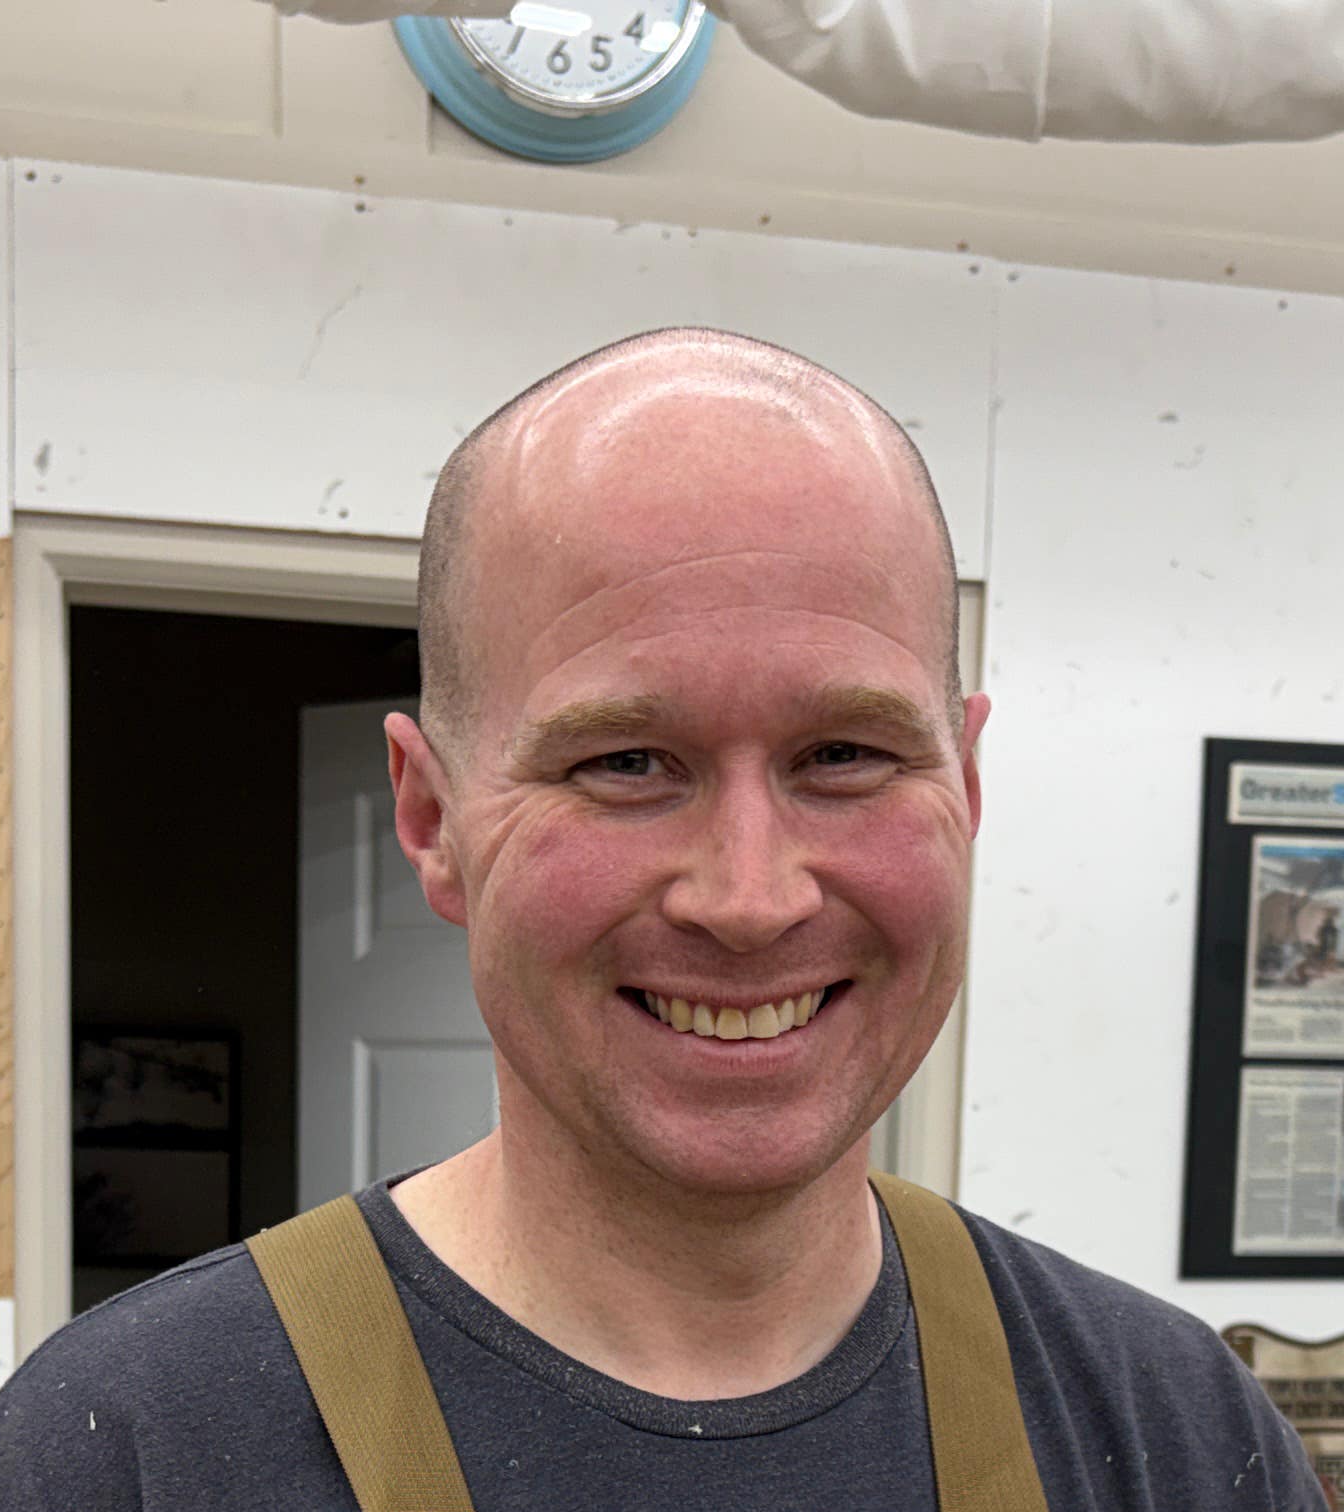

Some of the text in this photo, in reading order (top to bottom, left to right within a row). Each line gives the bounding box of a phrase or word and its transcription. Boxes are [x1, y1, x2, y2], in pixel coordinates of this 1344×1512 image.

[546, 39, 572, 75] 6
[588, 35, 613, 72] 5
[623, 12, 646, 46] 4
